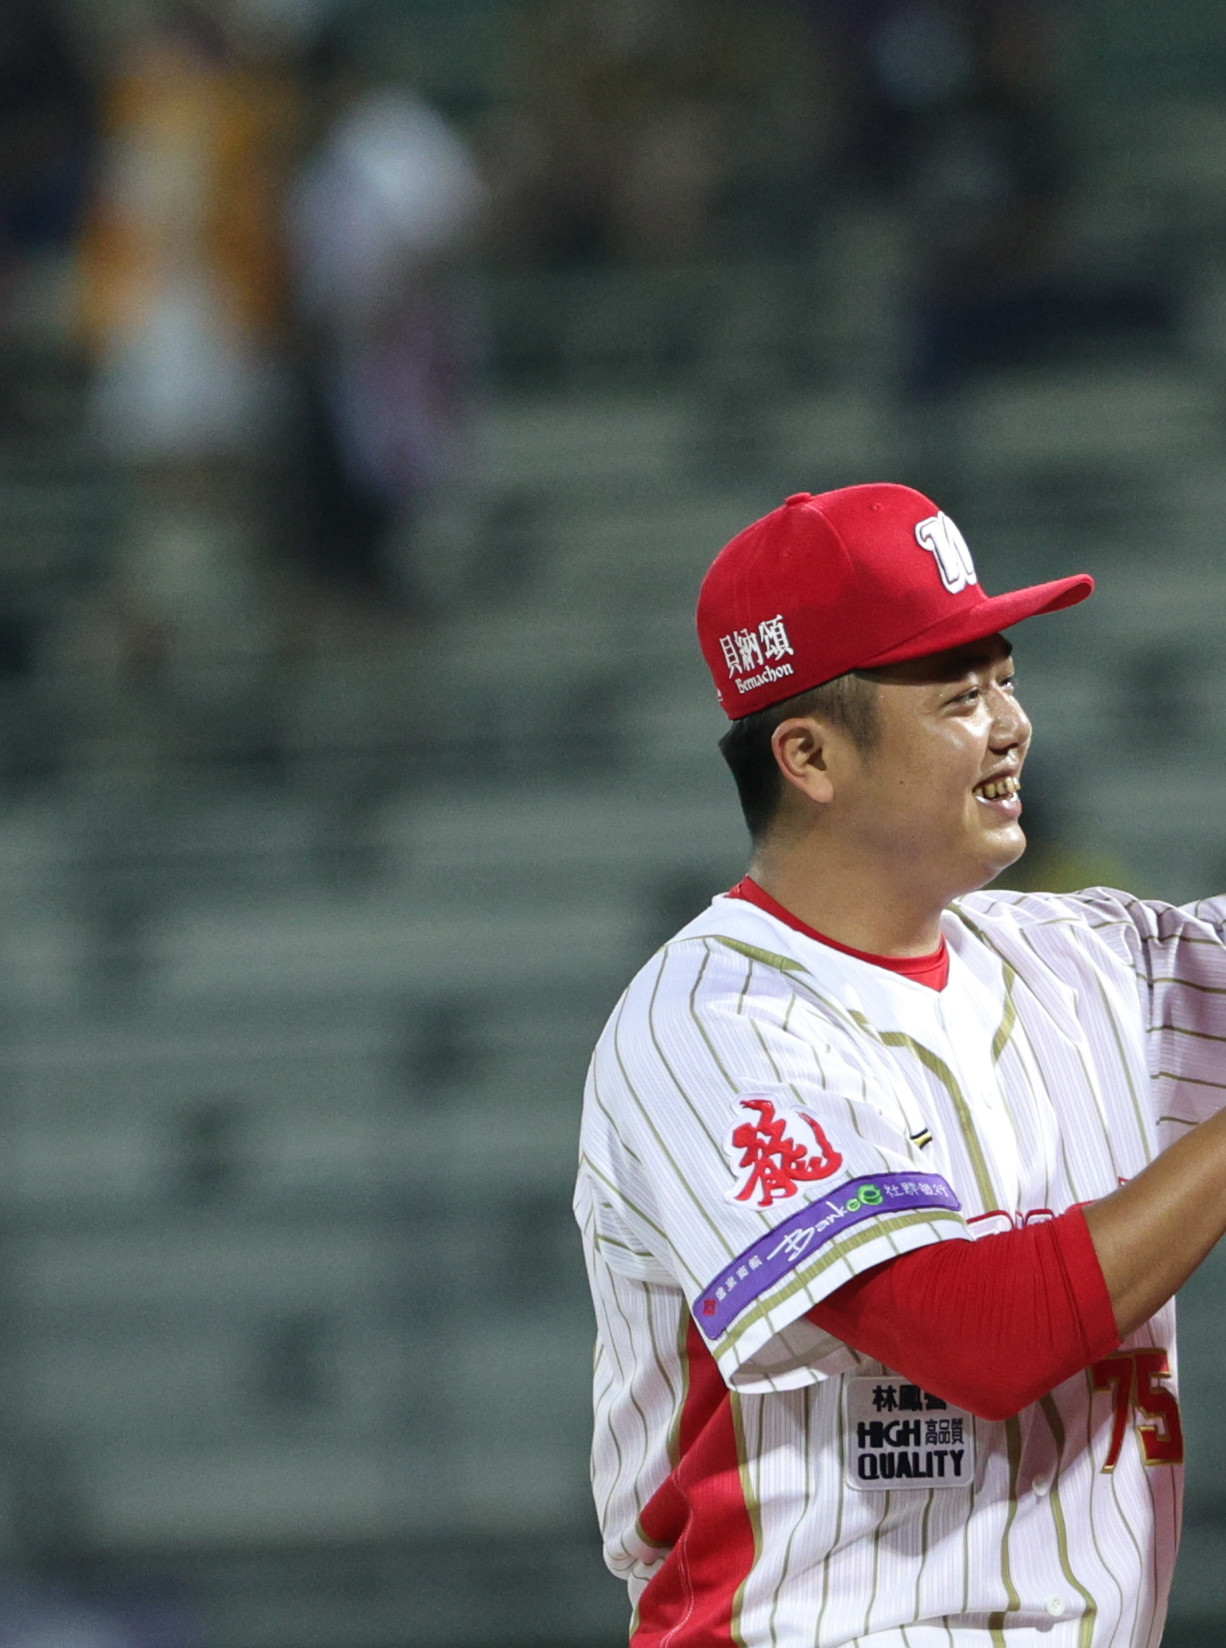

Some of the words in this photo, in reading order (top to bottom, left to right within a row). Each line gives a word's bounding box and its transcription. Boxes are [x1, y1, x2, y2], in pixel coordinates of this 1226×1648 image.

[719, 613, 795, 679] 貝納頌
[734, 663, 794, 694] Bernachon
[1092, 1347, 1184, 1475] 75
[856, 1420, 921, 1448] HIGH
[924, 1418, 964, 1445] 高品質
[858, 1450, 964, 1480] QUALITY
